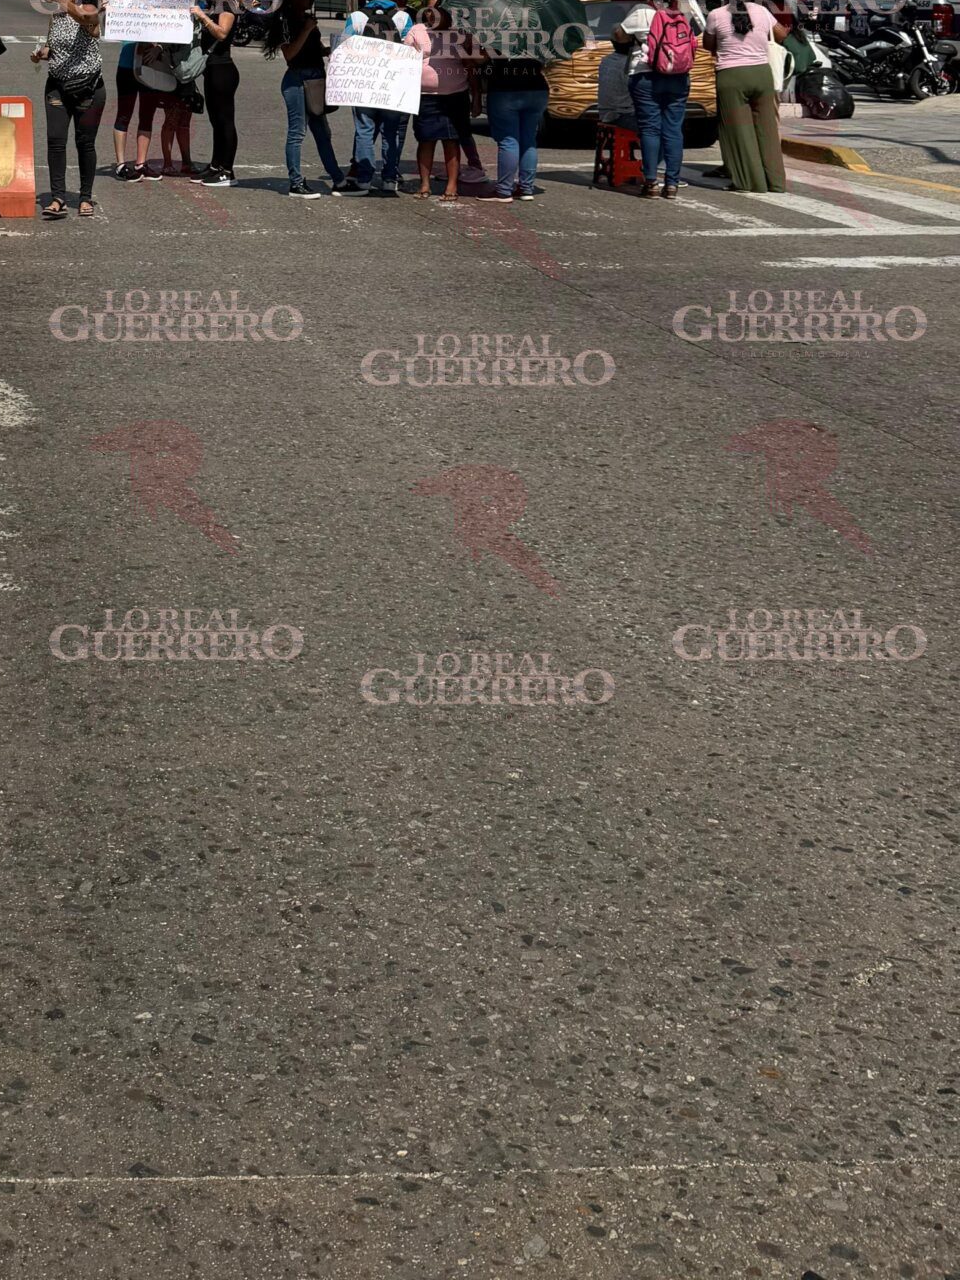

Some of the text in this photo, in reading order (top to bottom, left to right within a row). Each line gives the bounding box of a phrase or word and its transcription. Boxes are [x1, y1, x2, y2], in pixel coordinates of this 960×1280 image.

[343, 53, 376, 66] BONO
[378, 58, 391, 69] DE
[328, 65, 379, 78] DESPENSA
[385, 70, 400, 81] DE
